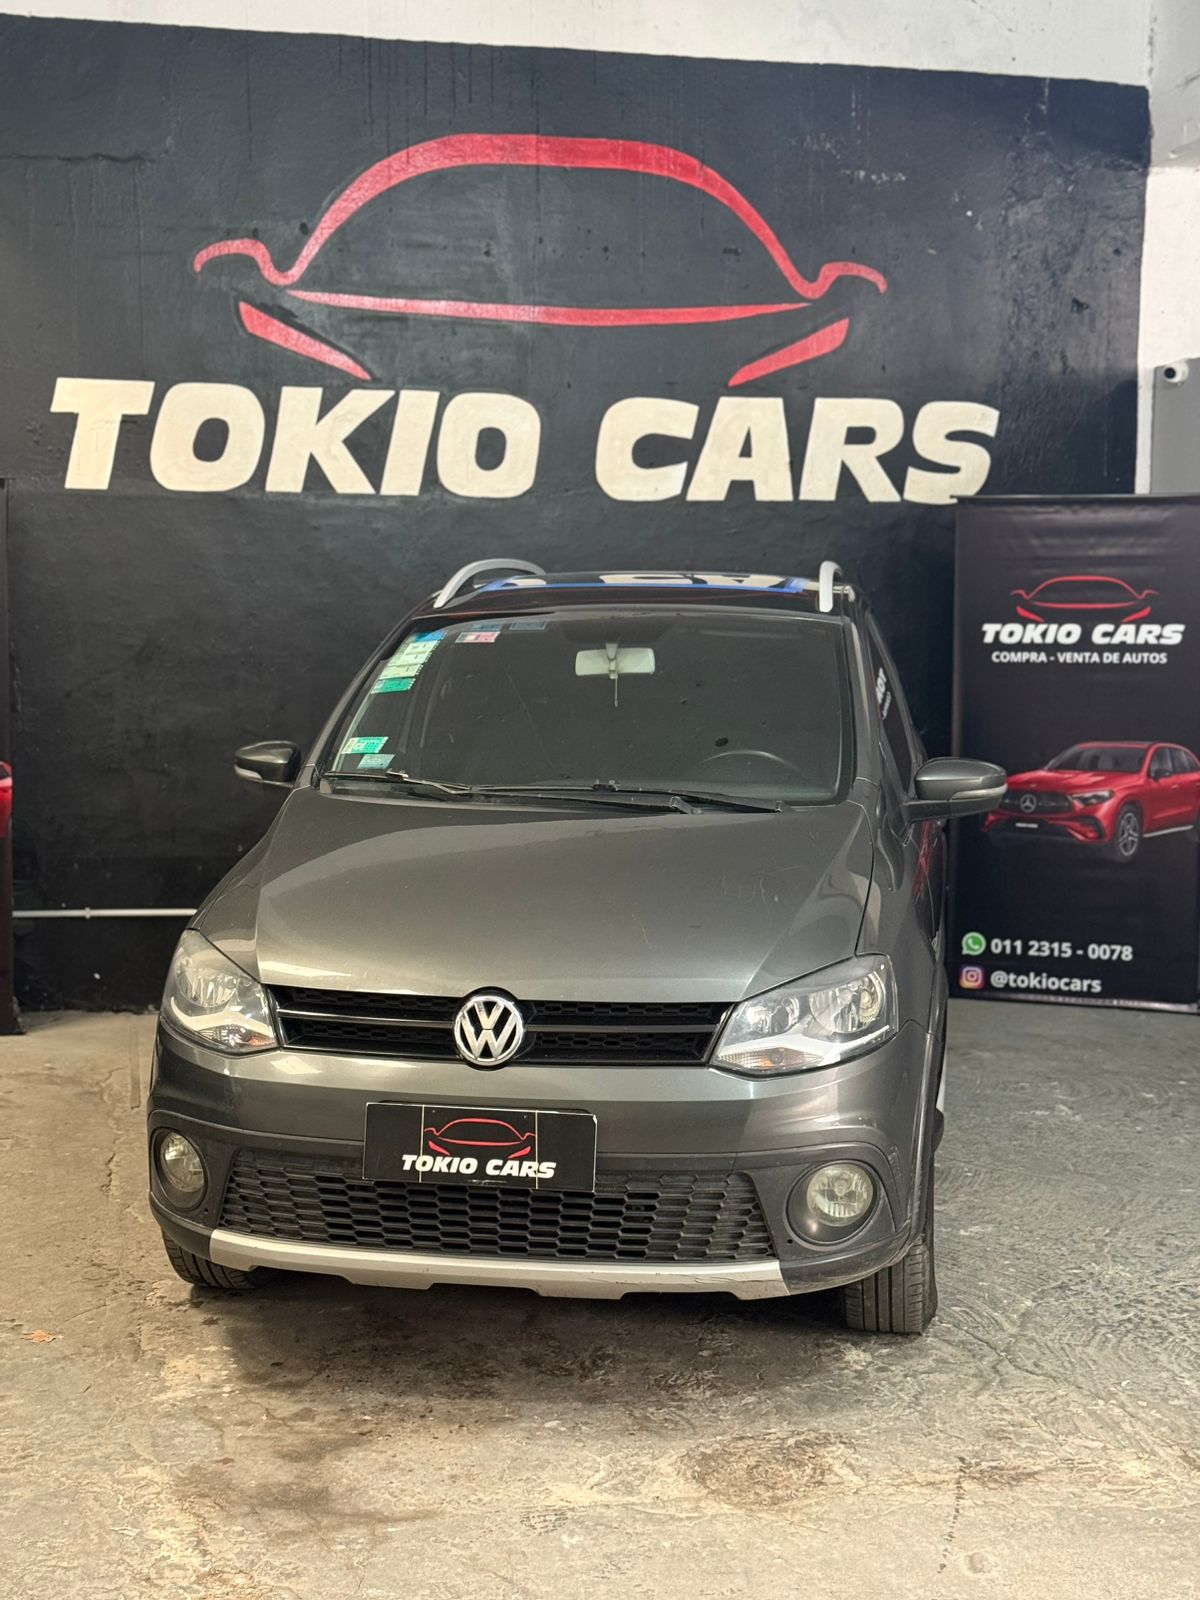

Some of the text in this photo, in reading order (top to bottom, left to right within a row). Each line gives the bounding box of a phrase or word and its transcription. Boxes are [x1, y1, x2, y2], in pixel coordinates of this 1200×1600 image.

[50, 377, 1000, 505] TOKIO CARS
[981, 622, 1186, 646] TOKIO CARS
[991, 650, 1048, 664] COMPRA
[1056, 651, 1101, 664] VENTA
[1102, 652, 1121, 664] DE
[1121, 652, 1168, 665] AUTOS
[990, 938, 1023, 955] 011
[1027, 940, 1073, 958] 2315
[1087, 943, 1133, 962] 0078
[990, 970, 1102, 993] @tokiocars
[458, 1000, 518, 1060] VW
[401, 1154, 557, 1179] TOKIO CARS
